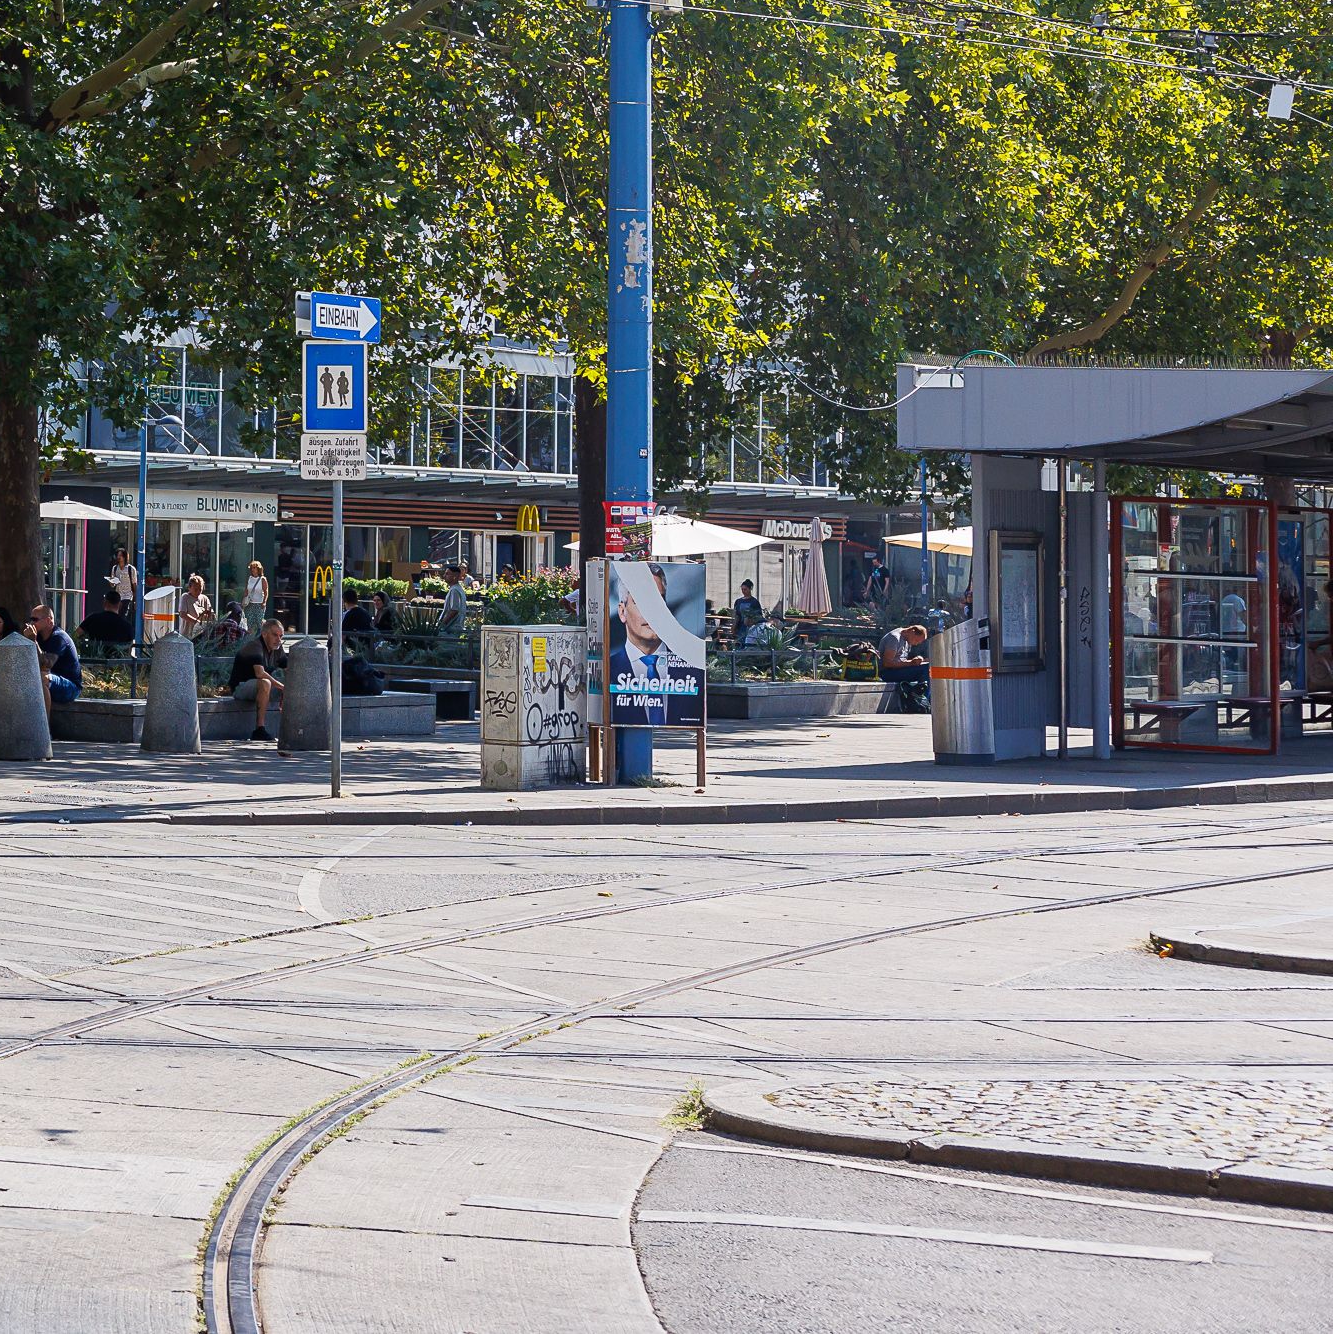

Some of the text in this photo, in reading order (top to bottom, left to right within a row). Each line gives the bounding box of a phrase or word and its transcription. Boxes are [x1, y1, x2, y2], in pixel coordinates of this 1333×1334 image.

[320, 306, 358, 328] EINBAHN
[335, 438, 358, 446] Zufahrt
[303, 458, 314, 466] mit
[197, 498, 242, 512] BLUMEN
[616, 672, 696, 692] Sicherheit
[616, 694, 664, 708] für Wien.
